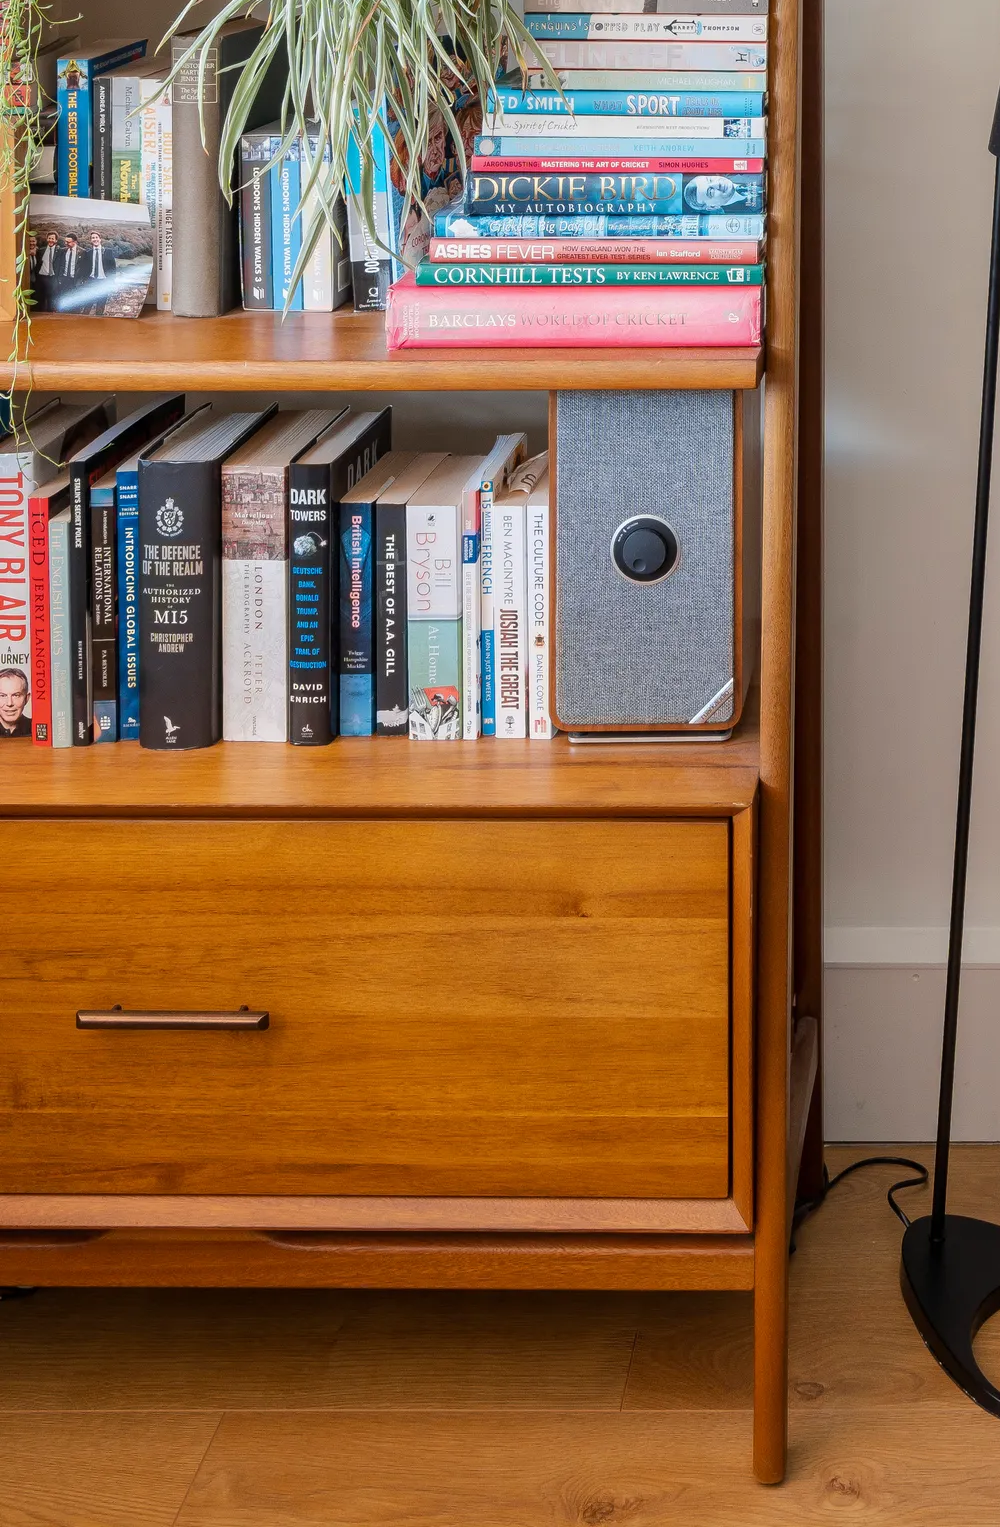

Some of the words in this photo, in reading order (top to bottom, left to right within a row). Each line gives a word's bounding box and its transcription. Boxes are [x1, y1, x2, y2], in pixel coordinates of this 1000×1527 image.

[526, 96, 575, 111] SMITH
[634, 144, 656, 152] KEITH
[660, 144, 694, 152] ANDREW
[252, 167, 260, 210] LONDON'S
[472, 176, 587, 202] DICKIE
[600, 176, 677, 202] BIRD
[495, 204, 516, 213] MY
[526, 204, 656, 213] AUTOBIOGRAPHY
[253, 212, 261, 244] HIDDEN
[489, 220, 534, 232] Cricket's
[538, 220, 556, 234] Big
[558, 220, 582, 235] Day
[584, 221, 604, 232] Out
[254, 246, 262, 275] WALKS
[434, 244, 492, 259] ASHES
[496, 245, 554, 260] FEVER
[670, 249, 700, 257] Stafford
[434, 267, 542, 284] CORNHILL
[547, 267, 606, 284] TESTS
[616, 272, 630, 281] BY
[633, 272, 656, 281] KEN
[658, 271, 720, 282] LAWRENCE
[428, 314, 516, 328] BARCLAYS
[520, 312, 584, 326] WORLD
[588, 313, 610, 326] OF
[615, 312, 688, 326] CRICKET
[0, 472, 24, 548] TONY
[290, 488, 326, 506] DARK
[482, 498, 492, 508] 15
[290, 510, 326, 522] TOWERS
[503, 515, 512, 536] BEN
[534, 514, 544, 536] THE
[32, 512, 46, 566] ICED
[351, 515, 362, 555] British
[386, 534, 395, 560] THE
[125, 527, 135, 602] INTRODUCING
[144, 544, 160, 560] THE
[161, 545, 201, 560] DEFENCE
[534, 540, 544, 590] CULTURE
[94, 547, 103, 600] RELATIONS
[142, 560, 151, 575] OF
[154, 562, 172, 576] THE
[173, 561, 204, 576] REALM
[386, 564, 395, 594] BEST
[410, 532, 436, 611] Bryson
[434, 560, 452, 587] Bill
[482, 546, 492, 595] FRENCH
[504, 542, 514, 605] MACINTYRE
[104, 547, 112, 624] INTERNATIONAL
[142, 588, 201, 596] AUTHORIZED
[254, 566, 263, 630] LONDON
[350, 558, 362, 628] Intelligence
[0, 558, 27, 642] BLAIR
[32, 578, 46, 622] JERRY
[152, 596, 191, 604] HISTORY
[386, 598, 395, 614] OF
[534, 594, 544, 626] CODE
[126, 606, 136, 648] GLOBAL
[154, 610, 188, 624] MI5
[500, 608, 518, 649] JOSIAH
[150, 632, 194, 642] CHRISTOPHER
[300, 634, 314, 642] EPIC
[386, 618, 395, 645] A.A.
[428, 626, 440, 640] At
[158, 643, 184, 652] ANDREW
[35, 629, 46, 700] LANGTON
[127, 652, 136, 688] ISSUES
[244, 642, 252, 704] ACKROYD
[254, 654, 262, 694] PETER
[386, 648, 395, 676] GILL
[428, 644, 440, 684] Home
[500, 652, 519, 671] THE
[536, 654, 544, 684] DANIEL
[290, 696, 326, 704] ENRICH
[292, 683, 324, 691] DAVID
[500, 674, 520, 710] GREAT
[536, 686, 544, 711] COYLE
